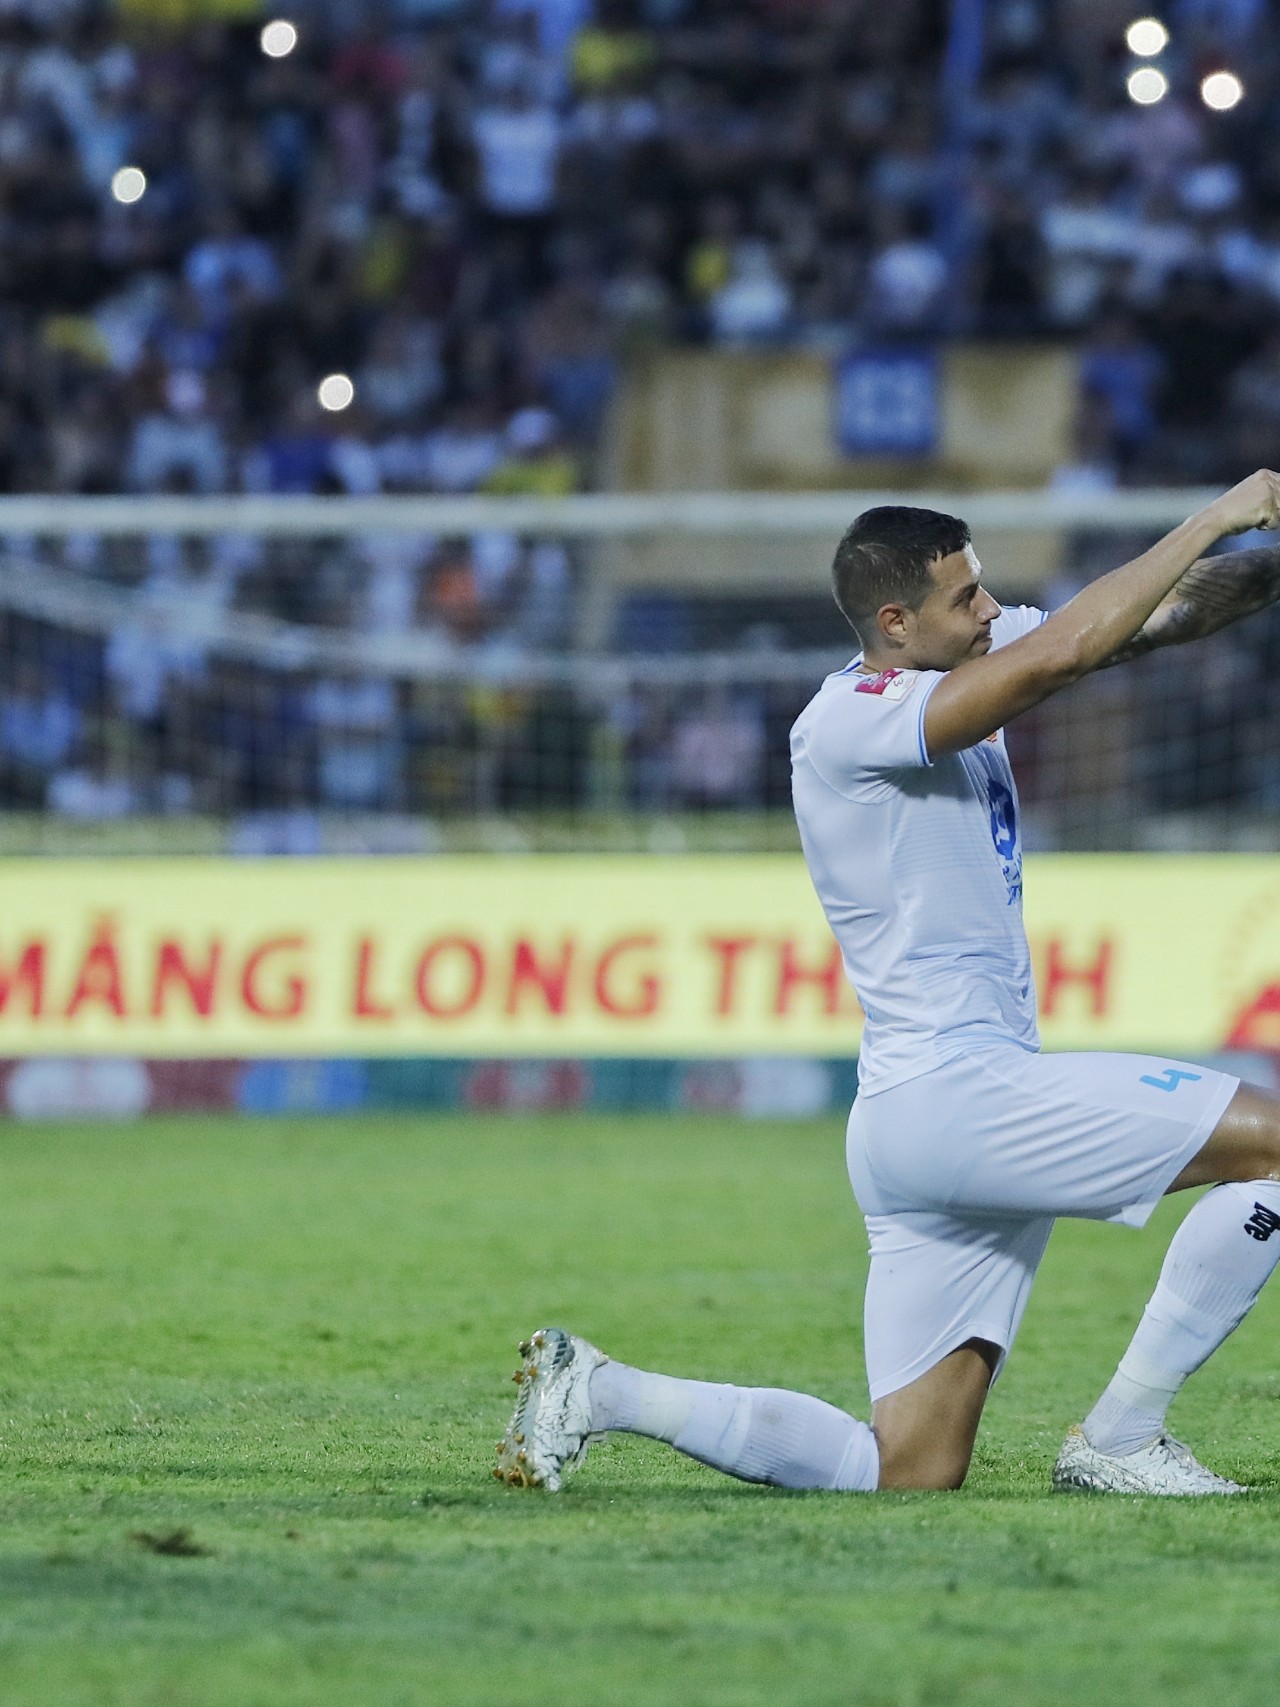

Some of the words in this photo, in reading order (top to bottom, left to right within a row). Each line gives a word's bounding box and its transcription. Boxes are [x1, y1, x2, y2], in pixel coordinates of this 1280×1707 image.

[351, 935, 662, 1021] LONG
[705, 935, 1115, 1018] THH
[1139, 1069, 1202, 1092] 4
